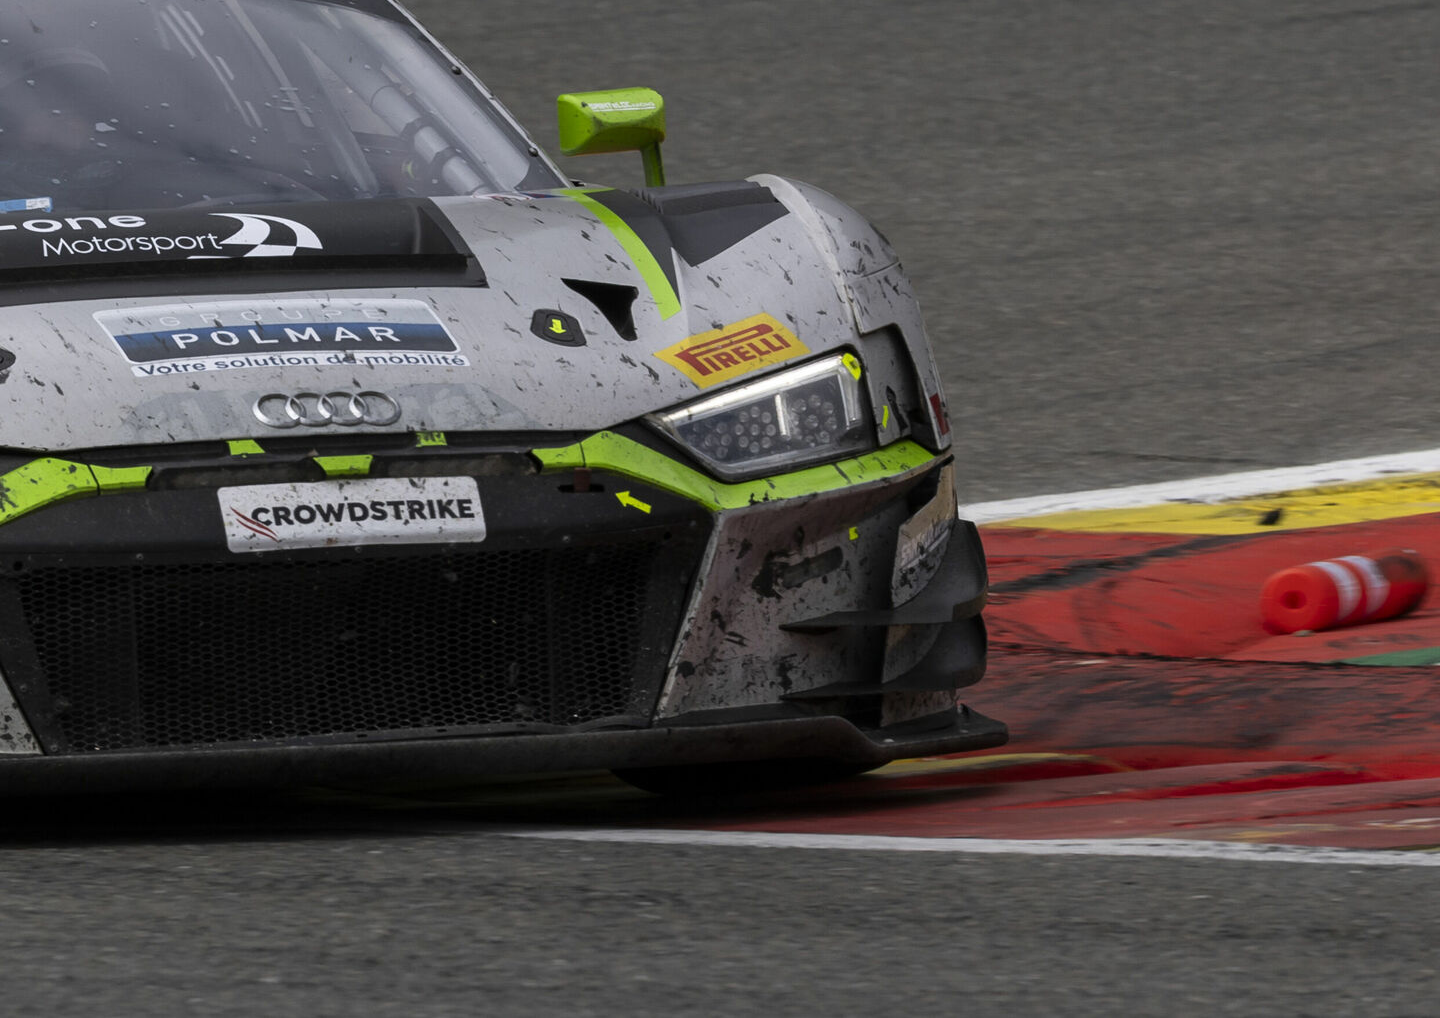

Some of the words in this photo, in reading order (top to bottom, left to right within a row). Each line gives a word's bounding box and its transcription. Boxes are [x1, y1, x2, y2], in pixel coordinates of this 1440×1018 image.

[42, 232, 223, 258] Motorsport
[170, 325, 401, 350] POLMAR
[673, 322, 793, 377] PIRELLI
[139, 361, 207, 376] Votre
[215, 354, 319, 371] solution
[364, 351, 466, 367] mobilité
[250, 498, 475, 528] CROWDSTRIKE
